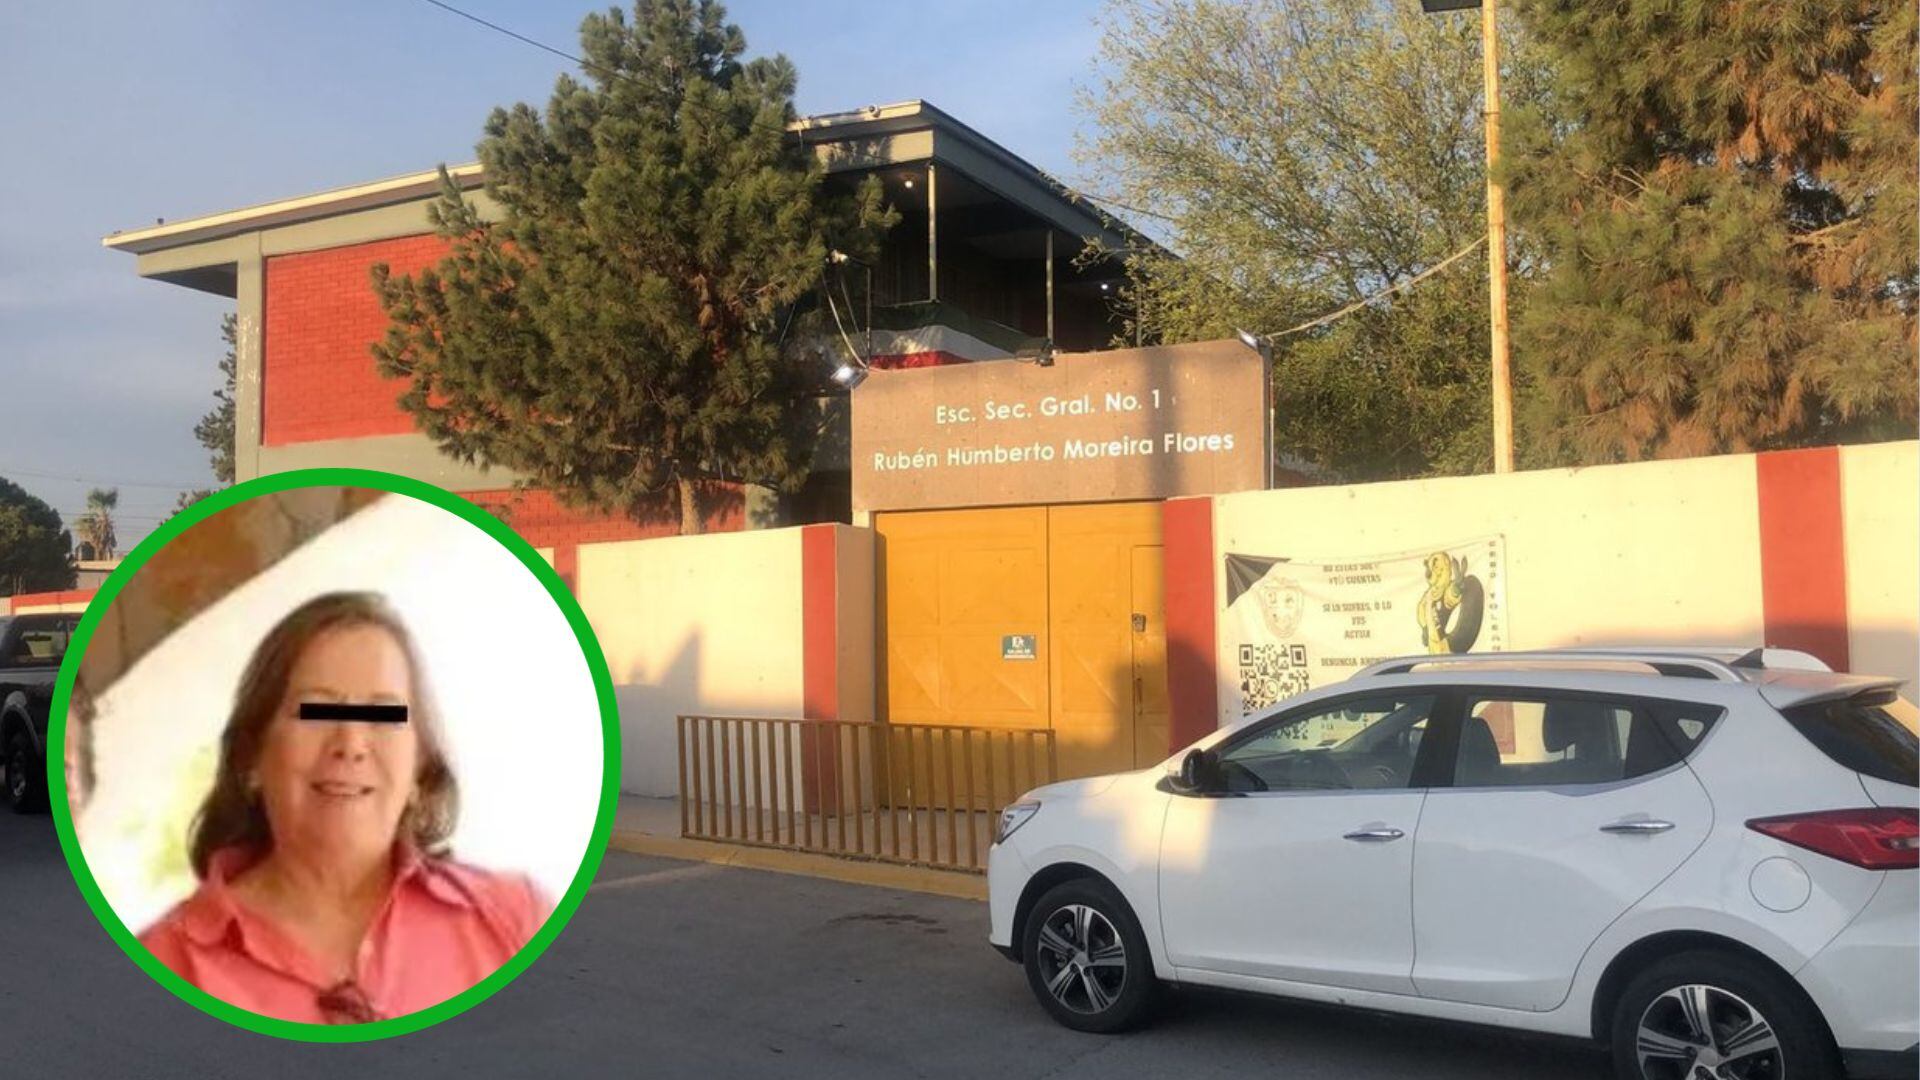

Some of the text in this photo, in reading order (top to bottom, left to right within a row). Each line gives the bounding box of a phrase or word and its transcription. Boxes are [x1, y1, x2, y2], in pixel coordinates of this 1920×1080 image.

[936, 389, 1160, 424] Esc. Sec. Gral. No. 1
[874, 433, 1234, 471] Rubén Humberto Moreira Flores
[1346, 574, 1381, 585] CUENTAS
